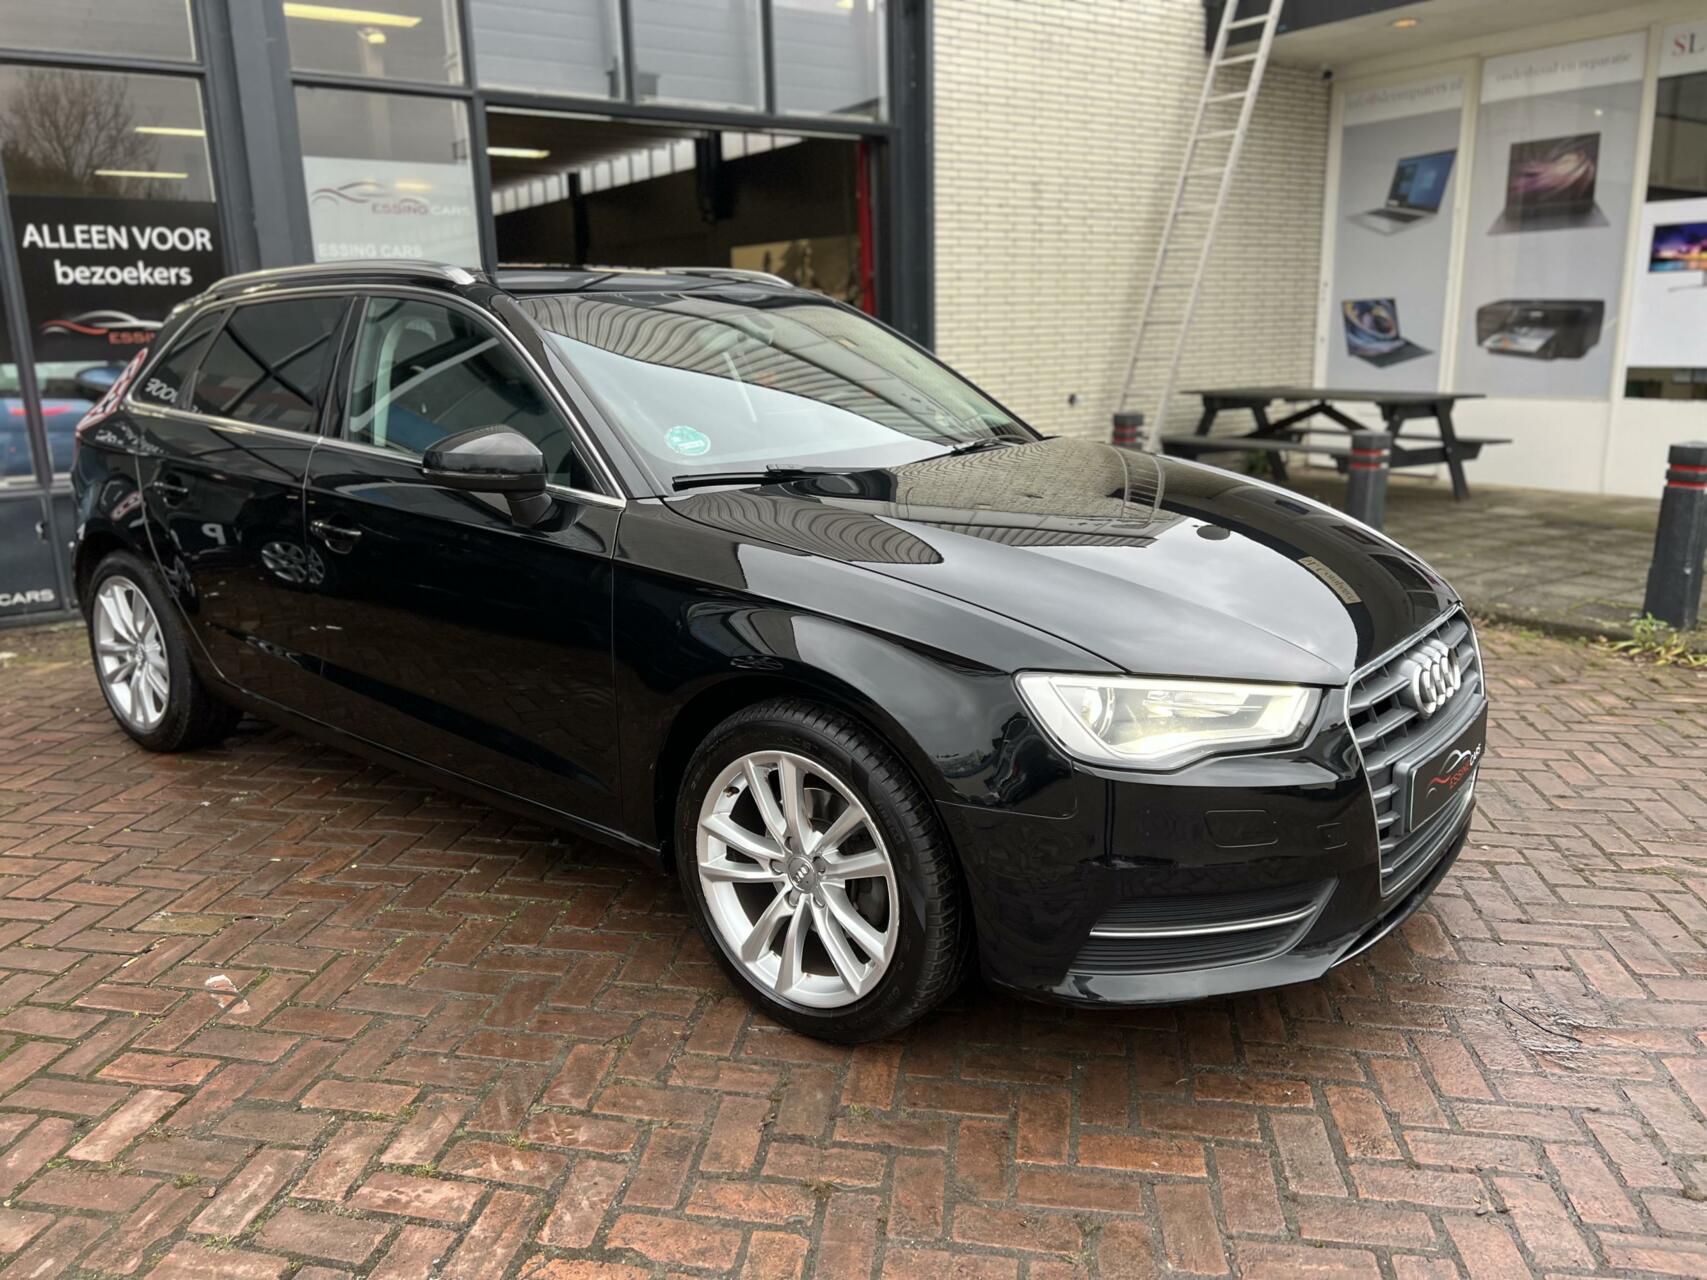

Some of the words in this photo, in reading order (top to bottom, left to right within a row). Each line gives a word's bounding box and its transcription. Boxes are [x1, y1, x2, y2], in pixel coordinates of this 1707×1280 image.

[22, 223, 129, 250] ALLEEN
[131, 226, 213, 251] VOOR
[380, 244, 423, 258] CARS
[54, 259, 193, 286] bezoekers
[0, 588, 55, 607] CARS
